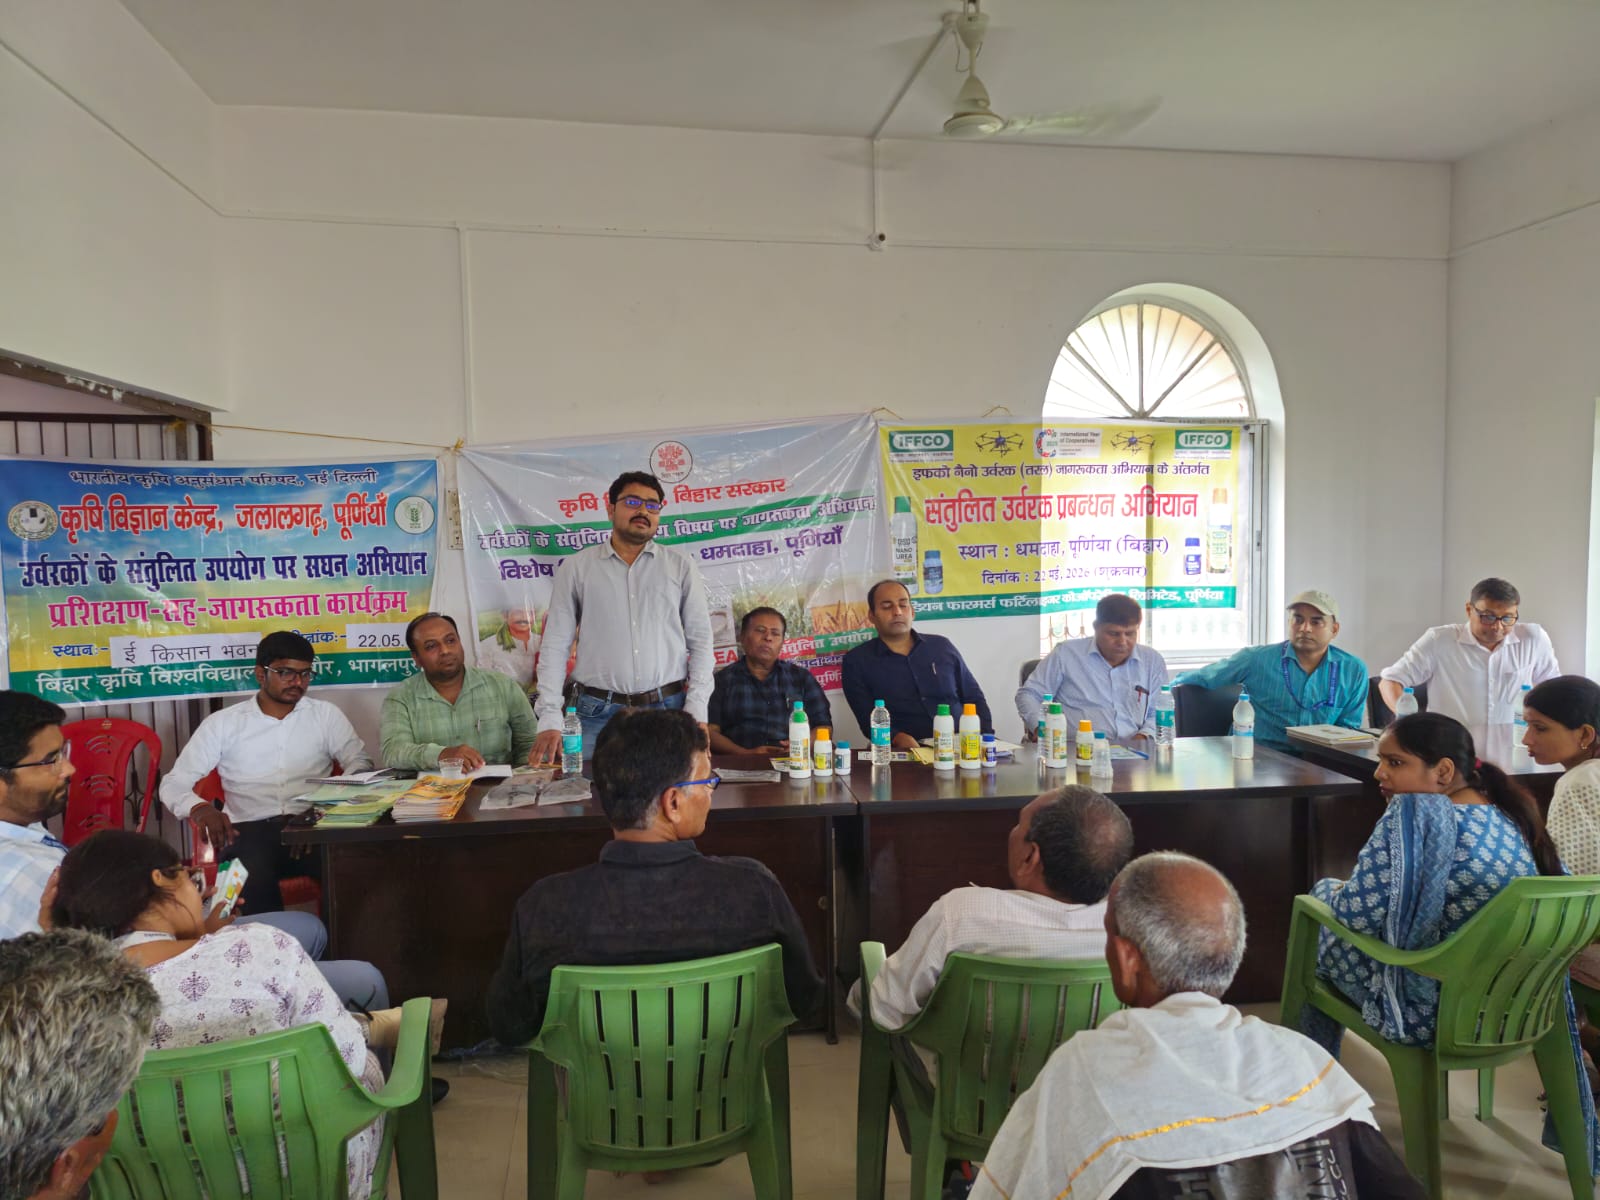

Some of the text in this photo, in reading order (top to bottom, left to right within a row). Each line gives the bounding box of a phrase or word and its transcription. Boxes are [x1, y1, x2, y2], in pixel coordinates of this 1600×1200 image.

[899, 435, 944, 447] IFFCO
[1185, 435, 1223, 445] IFFCO
[70, 470, 131, 486] भारतीय
[134, 471, 171, 488] कृषि
[175, 473, 246, 489] अनुसंधान
[306, 470, 329, 486] नई
[333, 468, 378, 484] दिल्ली
[913, 461, 1210, 480] इफको नैनो उर्वरक (तरल) जागरूकता अभियान के अंतर्गत
[558, 493, 598, 518] कृषि
[673, 484, 722, 505] बिहार
[726, 478, 787, 497] सरकार
[925, 485, 1198, 532] संतुलित उर्वरक प्रबन्धन अभियान
[59, 493, 388, 543] कृषि विज्ञान केन्द्र, जलालगढ़, पूर्णियाँ
[477, 528, 530, 550] उर्वरकों
[533, 531, 550, 547] के
[555, 527, 612, 550] संतुलित
[673, 518, 714, 537] विषय
[718, 515, 738, 530] पर
[817, 495, 876, 517] अभियान
[499, 524, 844, 580] विशेष धमदाहा, पूर्णियाँ
[958, 544, 998, 560] स्थान
[1016, 541, 1065, 558] धमदाहा,
[1069, 535, 1111, 558] पूर्णिया
[1117, 535, 1169, 554] (बिहार)
[19, 546, 427, 592] उर्वरकों के संतुलित उपयोग पर सघन अभियान
[982, 569, 1020, 584] दिनांक
[325, 586, 408, 616] कार्यक्रम
[912, 600, 944, 613] डियन
[947, 596, 996, 611] फारमर्स
[125, 641, 136, 664] ई
[152, 643, 210, 664] किसान
[222, 643, 258, 659] भवन
[358, 634, 404, 648] 22.05.
[831, 629, 874, 647] उपयोग
[36, 671, 92, 695] बिहार
[97, 667, 143, 693] कृषि
[149, 662, 255, 686] विश्वविद्याल
